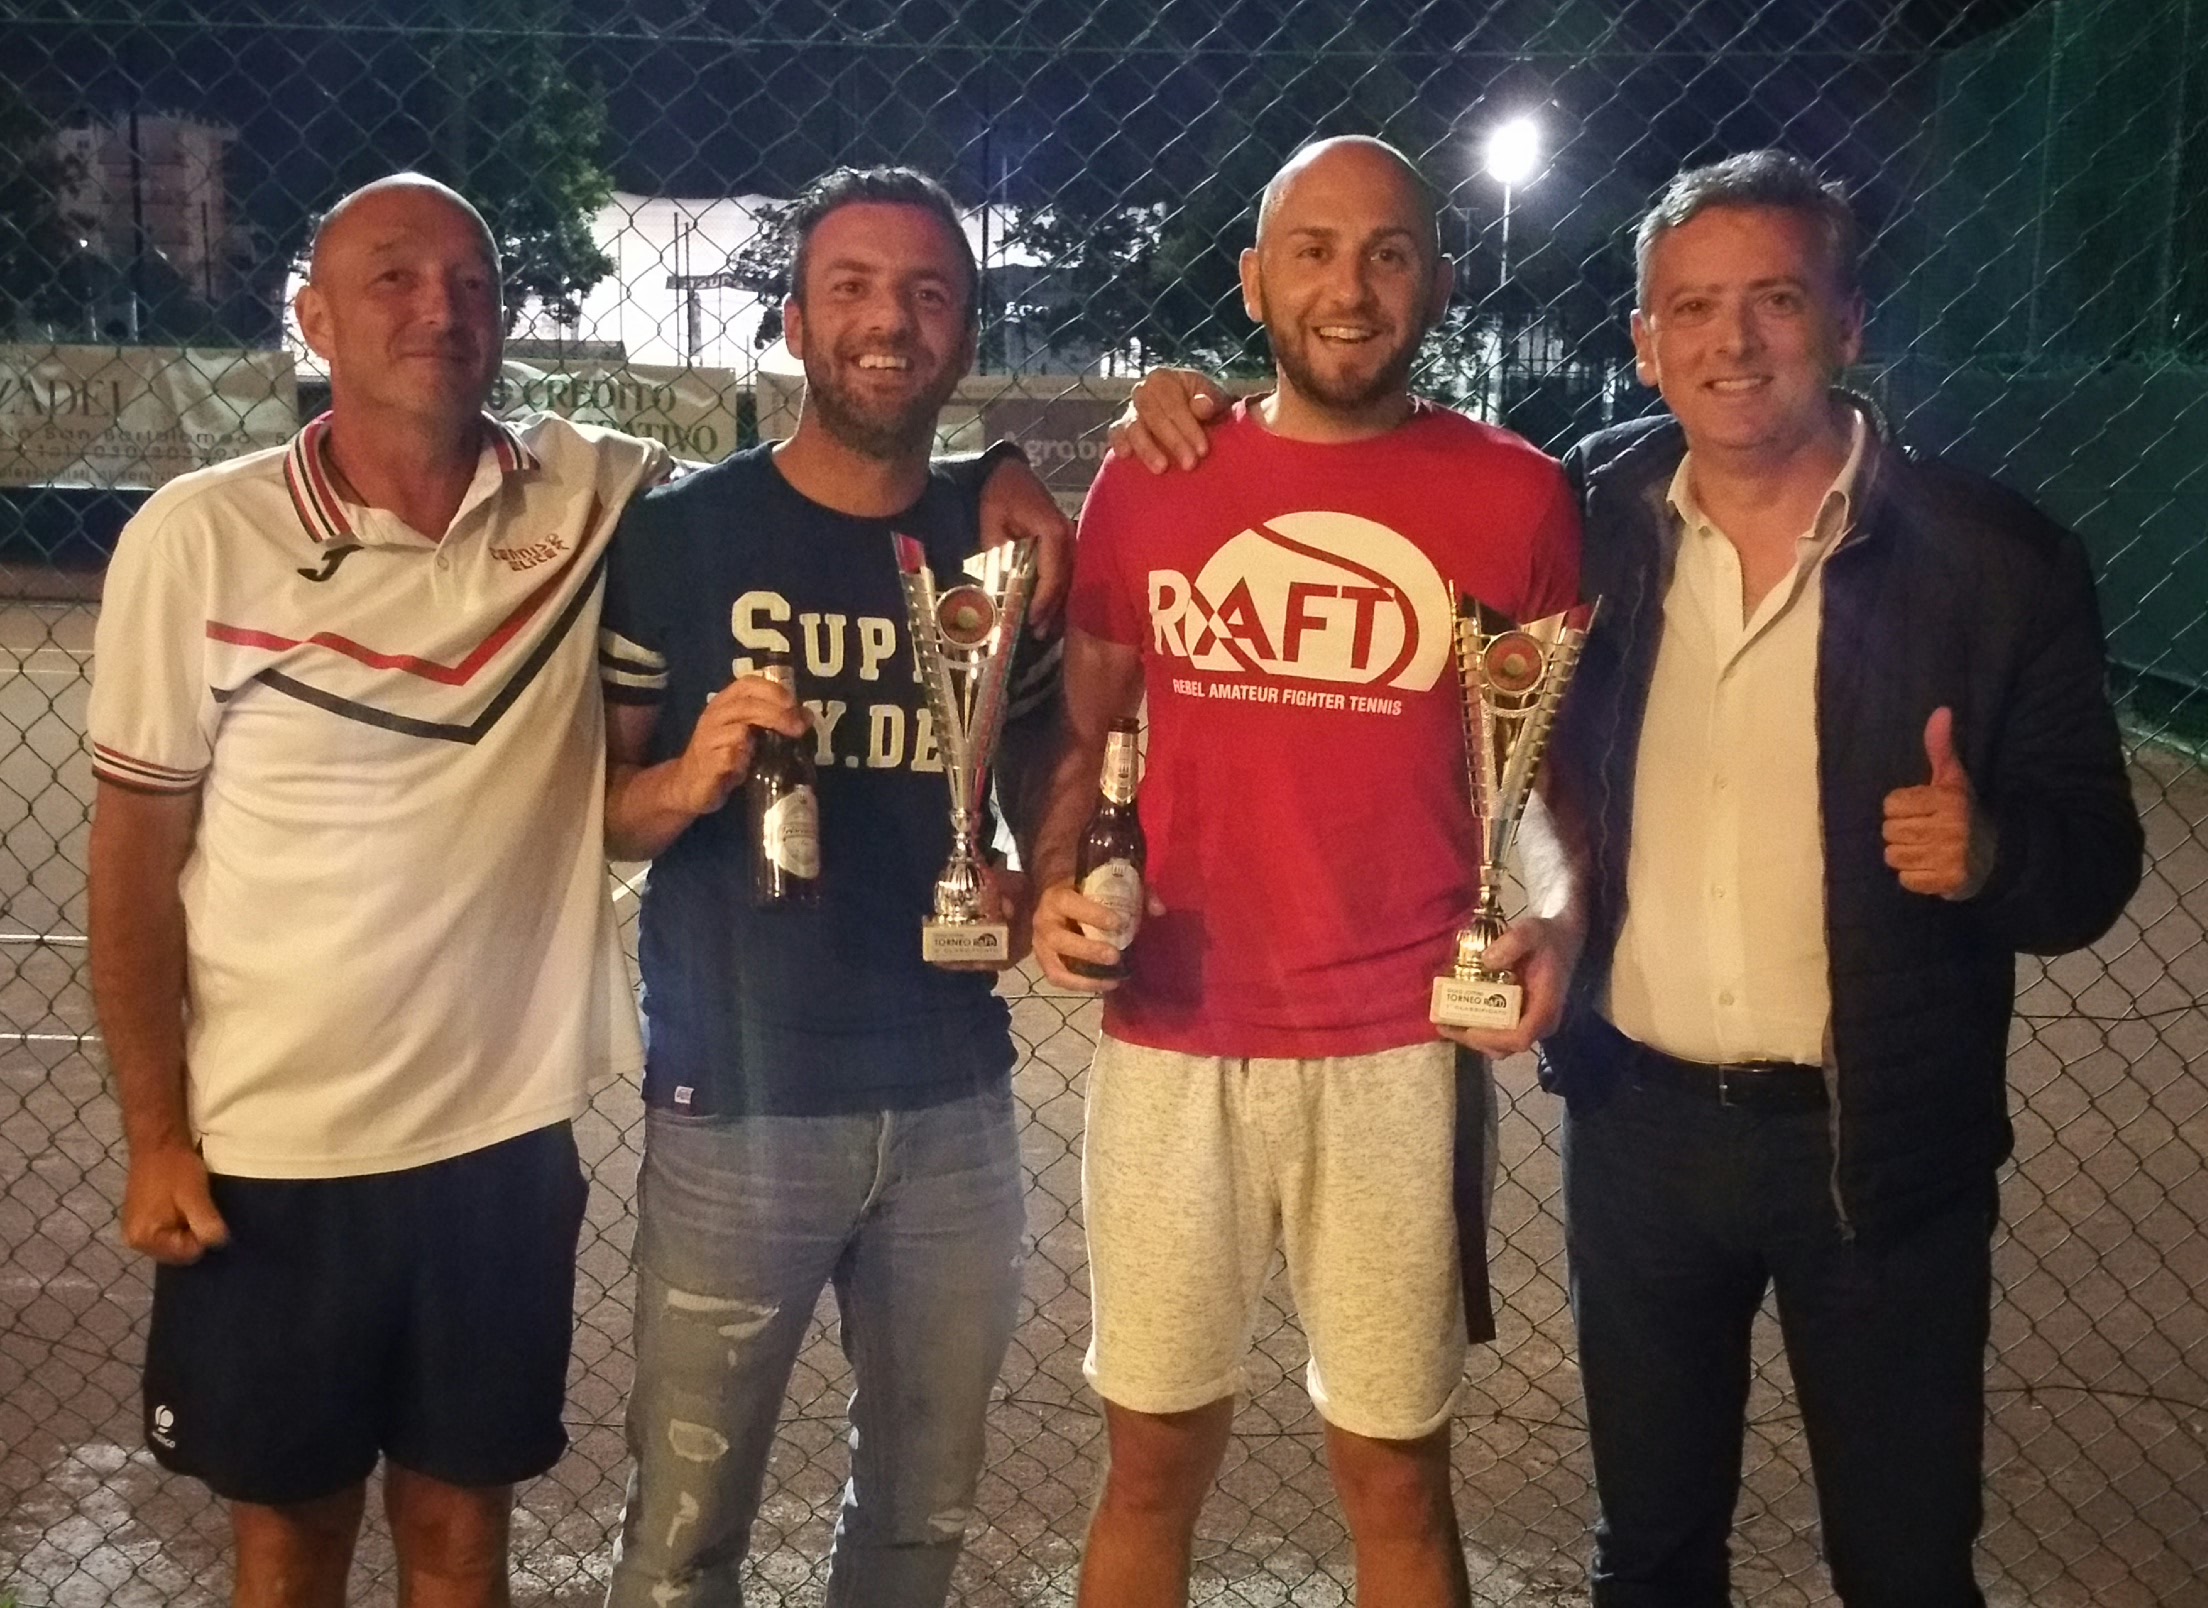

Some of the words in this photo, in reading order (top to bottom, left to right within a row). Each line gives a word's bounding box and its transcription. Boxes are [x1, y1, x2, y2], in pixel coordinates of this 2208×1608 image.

[522, 378, 677, 413] CREDITO
[575, 419, 718, 454] ATIVO
[731, 591, 923, 684] SUP
[1172, 678, 1206, 698] REBEL
[1208, 683, 1279, 704] AMATEUR
[1282, 688, 1345, 711] FIGHTER
[1348, 695, 1403, 717] TENNIS
[1446, 993, 1482, 1005] TORNEO
